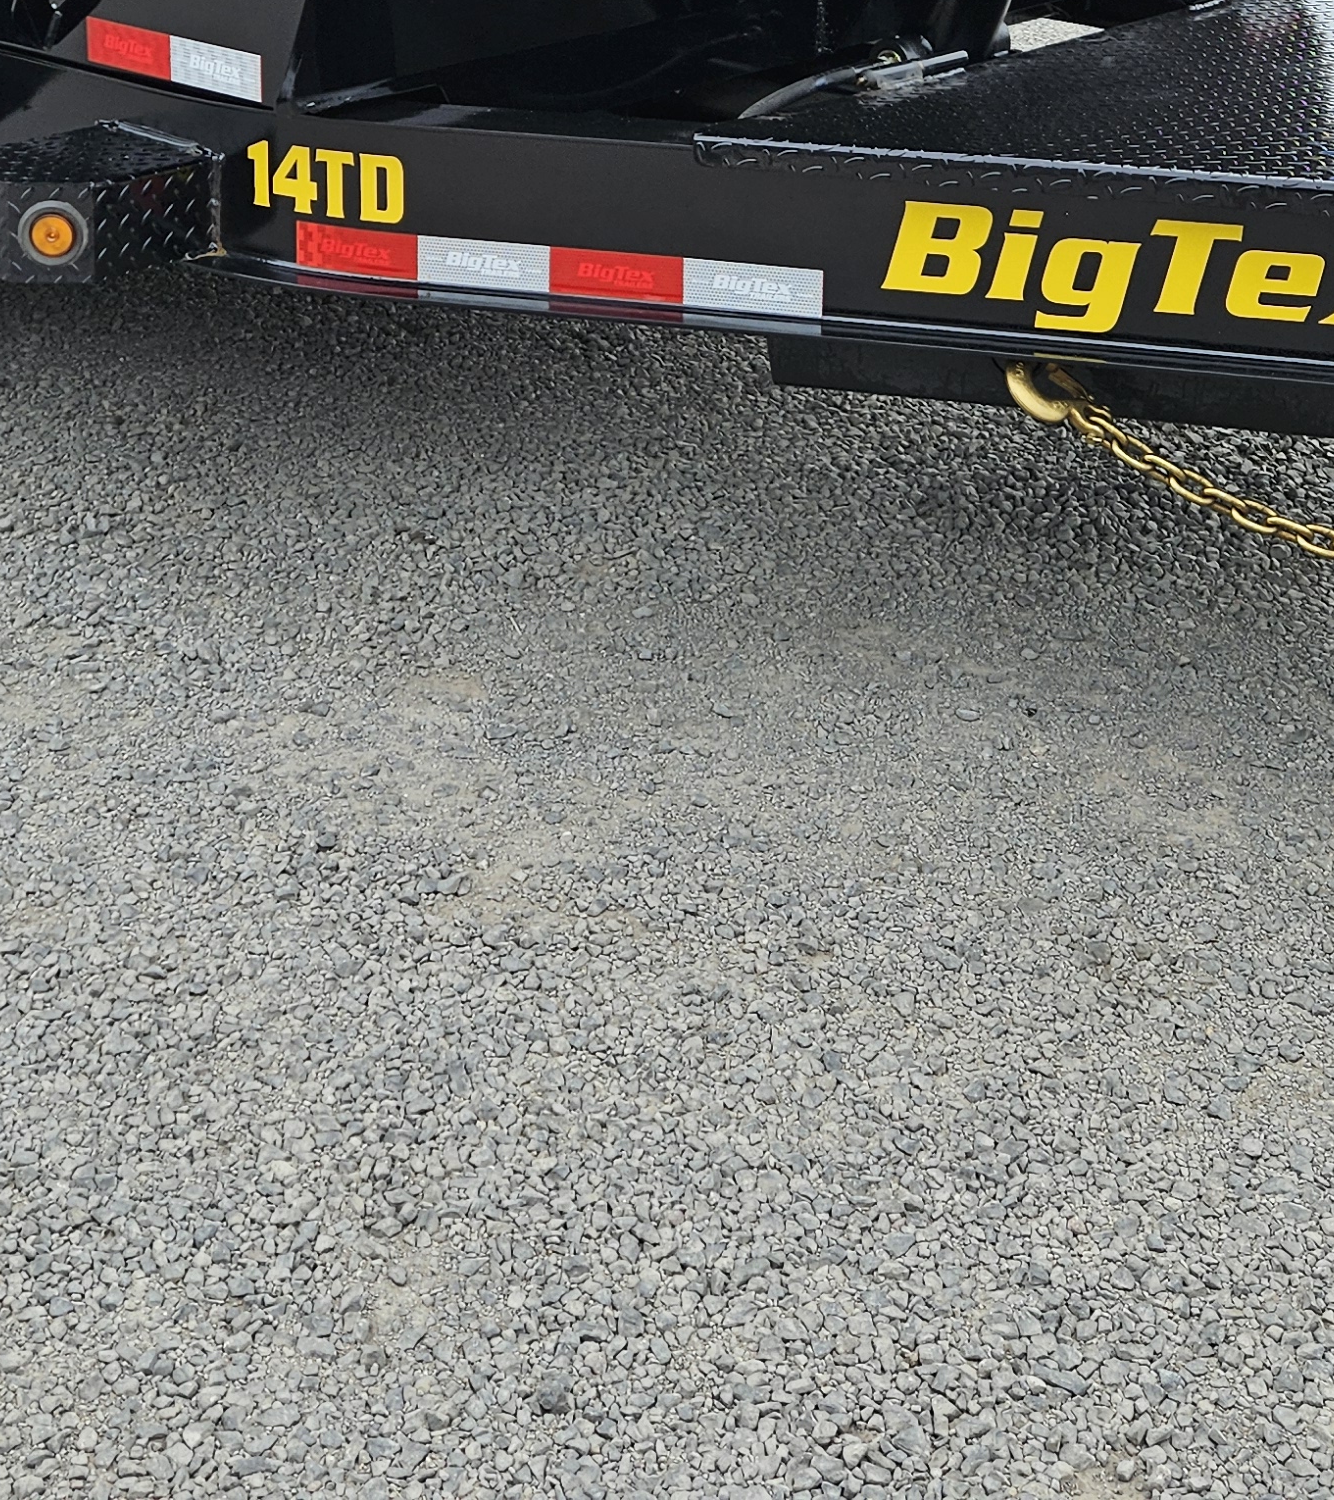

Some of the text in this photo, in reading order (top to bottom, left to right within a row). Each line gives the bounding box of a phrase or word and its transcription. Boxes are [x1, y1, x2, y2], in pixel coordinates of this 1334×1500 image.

[103, 34, 154, 57] BigTex
[189, 53, 242, 79] BigTex
[246, 139, 405, 225] 14TD
[320, 237, 391, 260] BigTex
[445, 250, 522, 272] BigTex
[576, 262, 655, 283] BigTex
[712, 274, 792, 295] BigTex
